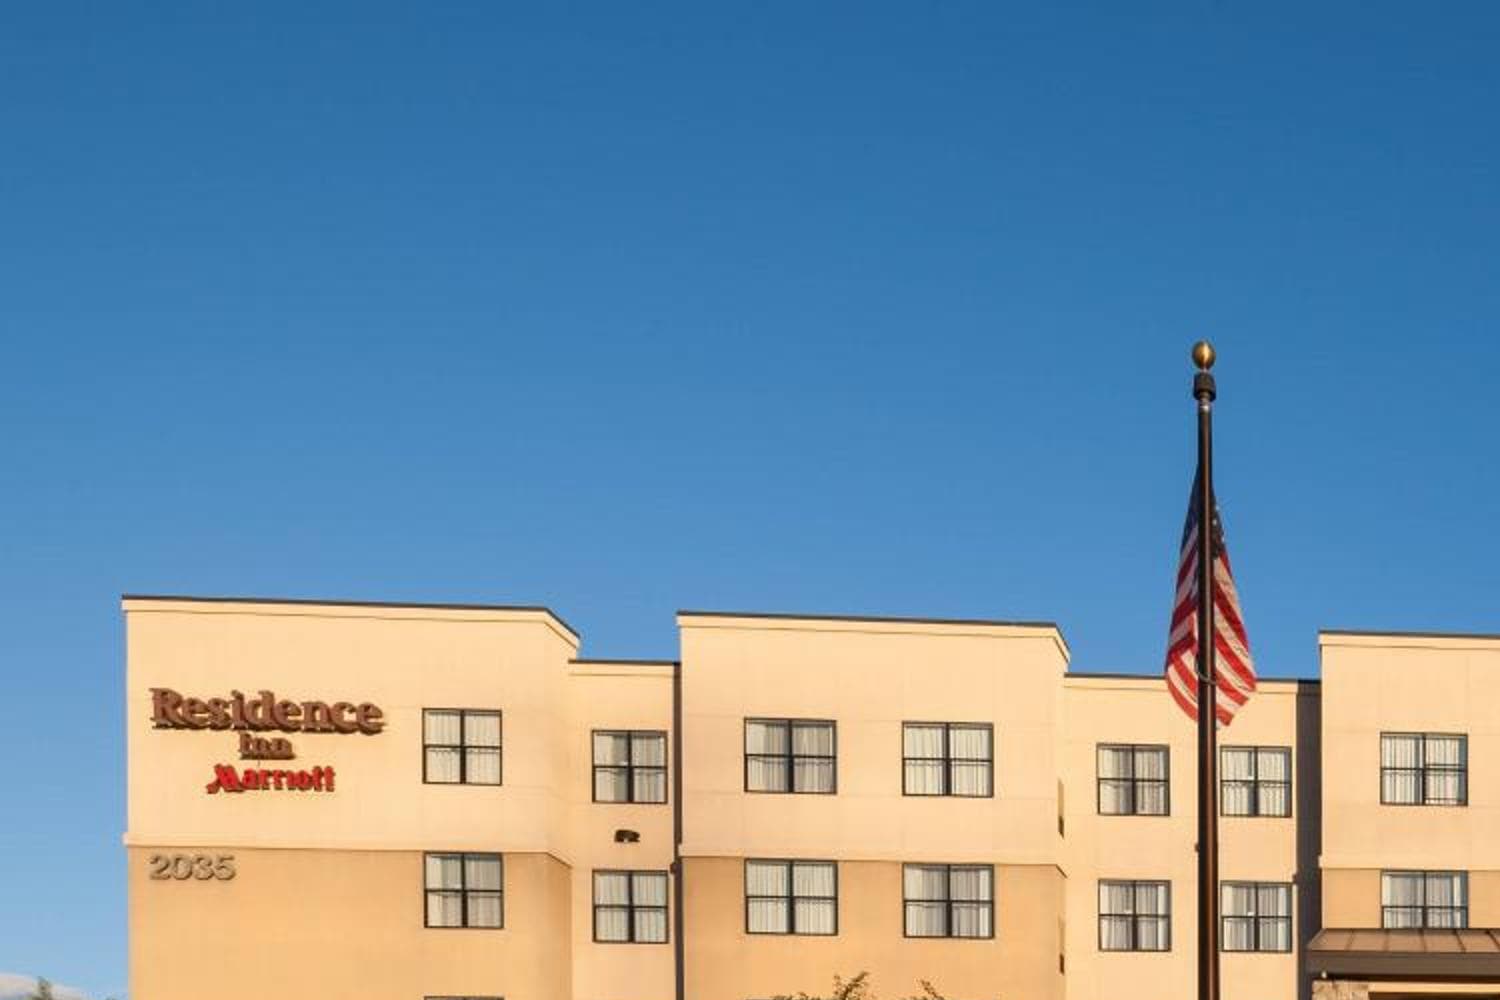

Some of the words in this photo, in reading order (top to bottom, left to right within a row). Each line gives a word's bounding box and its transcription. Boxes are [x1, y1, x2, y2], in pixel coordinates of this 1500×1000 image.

[149, 688, 386, 735] Residence
[238, 732, 296, 760] Inn
[206, 763, 335, 794] Marriott
[149, 854, 236, 880] 2035
